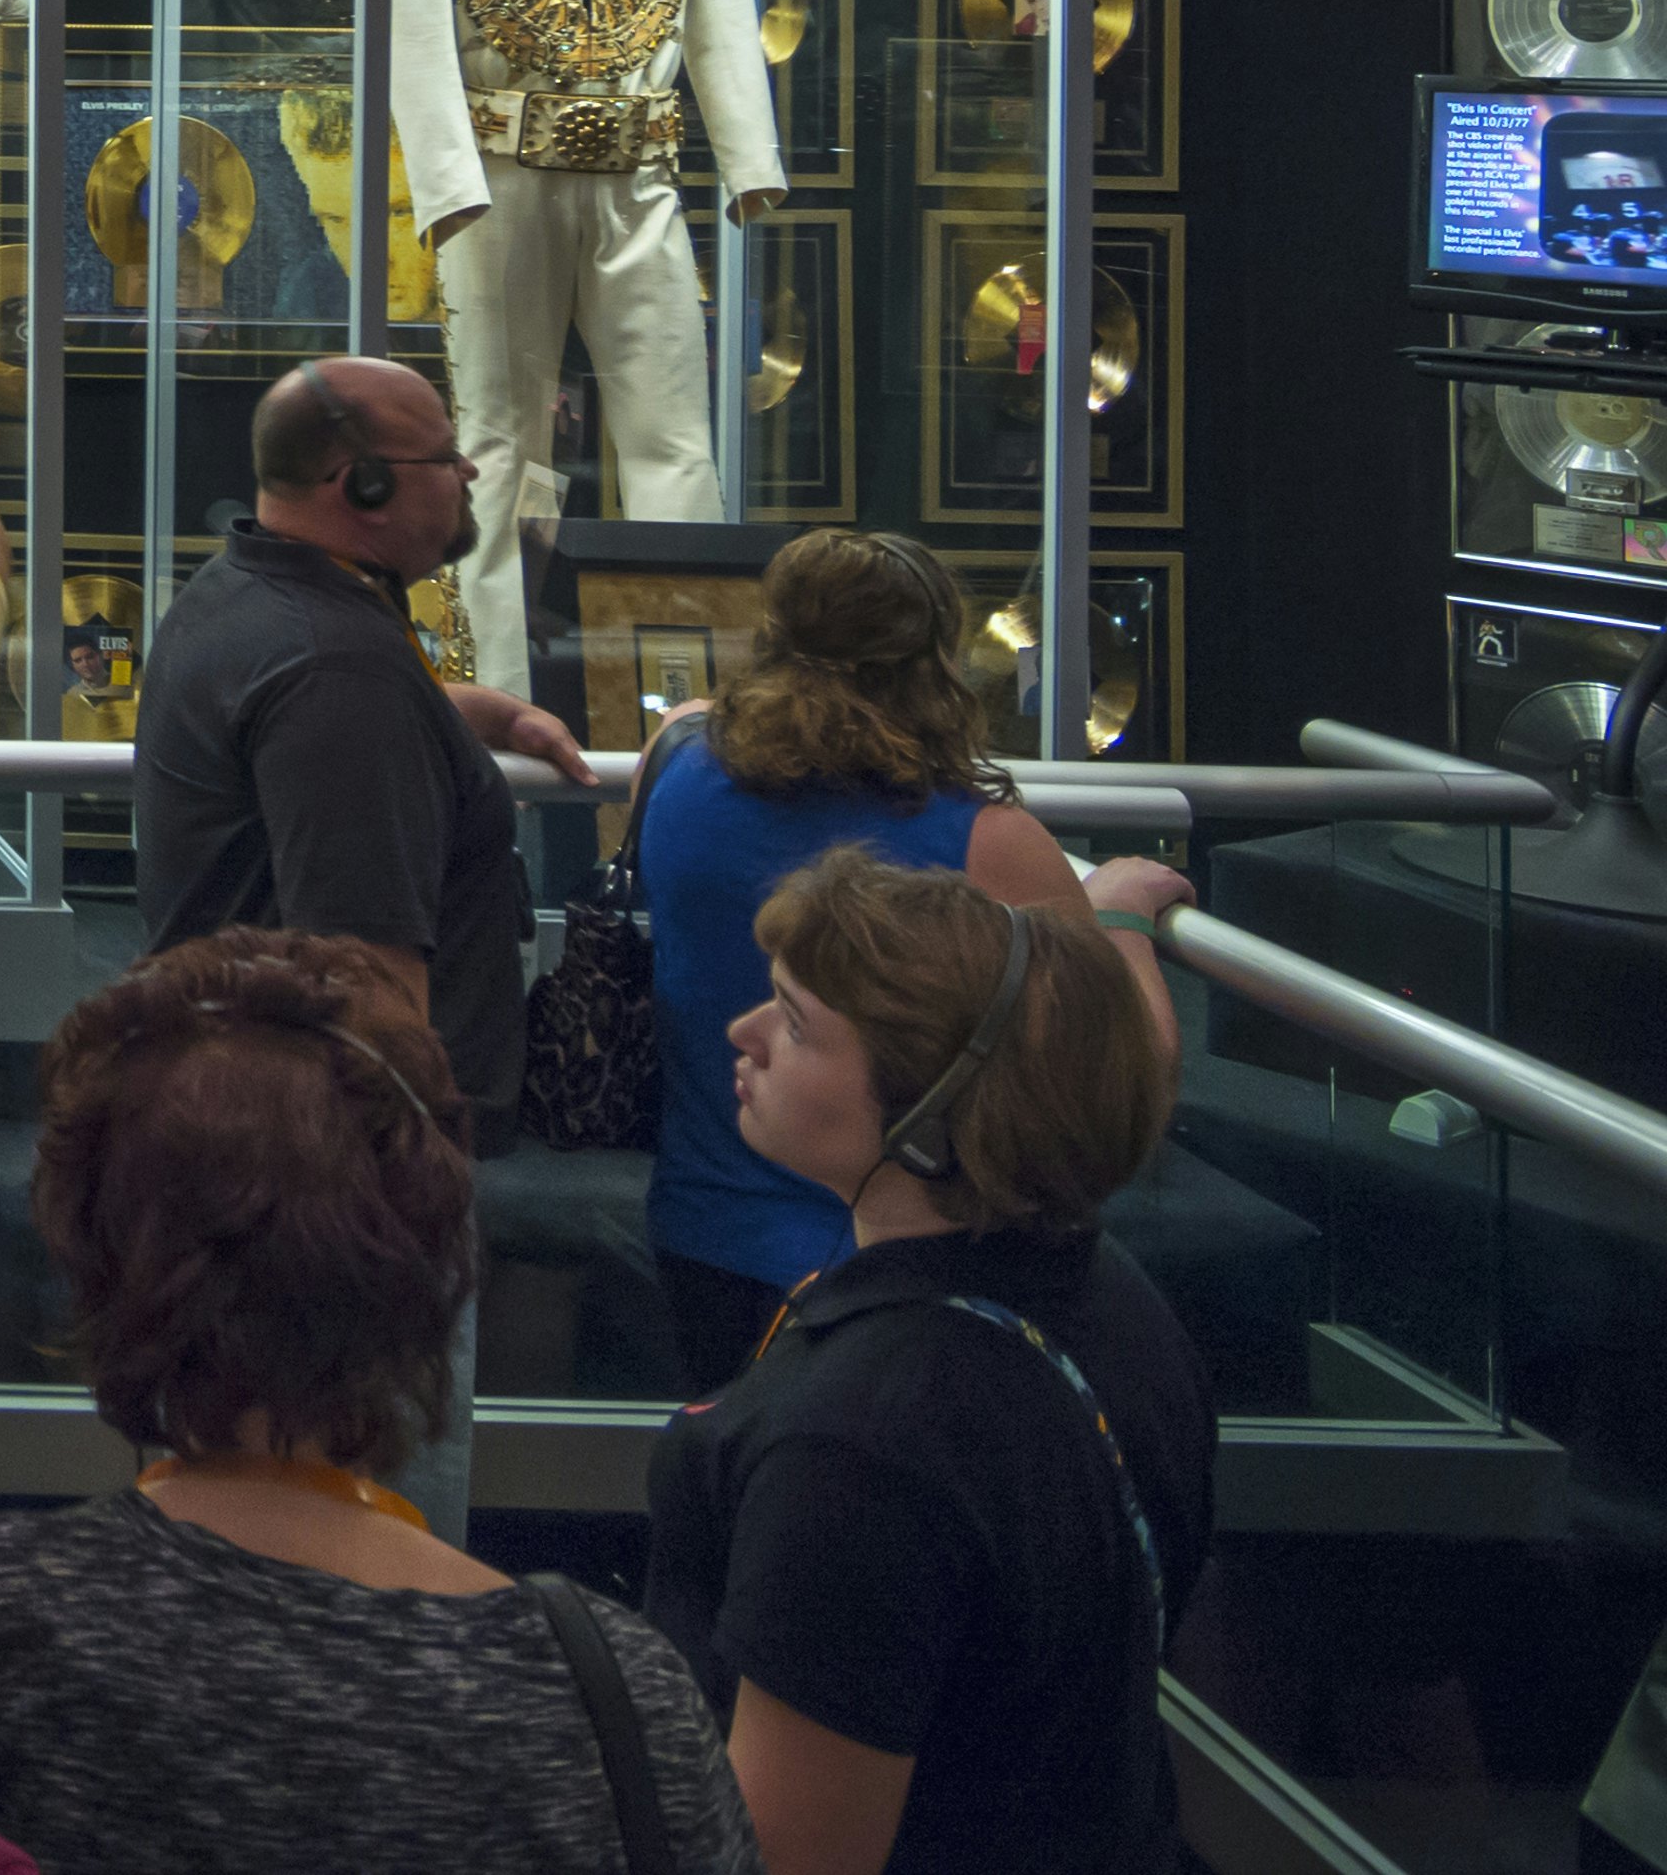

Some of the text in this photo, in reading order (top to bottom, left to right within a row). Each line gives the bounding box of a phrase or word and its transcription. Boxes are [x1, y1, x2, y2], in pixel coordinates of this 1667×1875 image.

[81, 102, 144, 111] ELVIS PRESLEY
[1490, 104, 1537, 115] Concert"
[1451, 117, 1529, 128] Aired 10/3/77
[1447, 131, 1464, 140] The
[1505, 133, 1524, 141] also
[1447, 141, 1466, 149] shot
[1467, 141, 1491, 150] video
[1472, 151, 1501, 162] airport
[1485, 170, 1503, 179] RCA
[1446, 180, 1509, 190] presented Elvis
[1445, 198, 1508, 208] golden records
[1445, 207, 1461, 215] this
[1445, 225, 1494, 238] The special
[1444, 235, 1521, 248] last professionally
[1443, 245, 1481, 255] recorded
[1582, 287, 1628, 298] SAMSUNG
[99, 636, 129, 650] ELVIS
